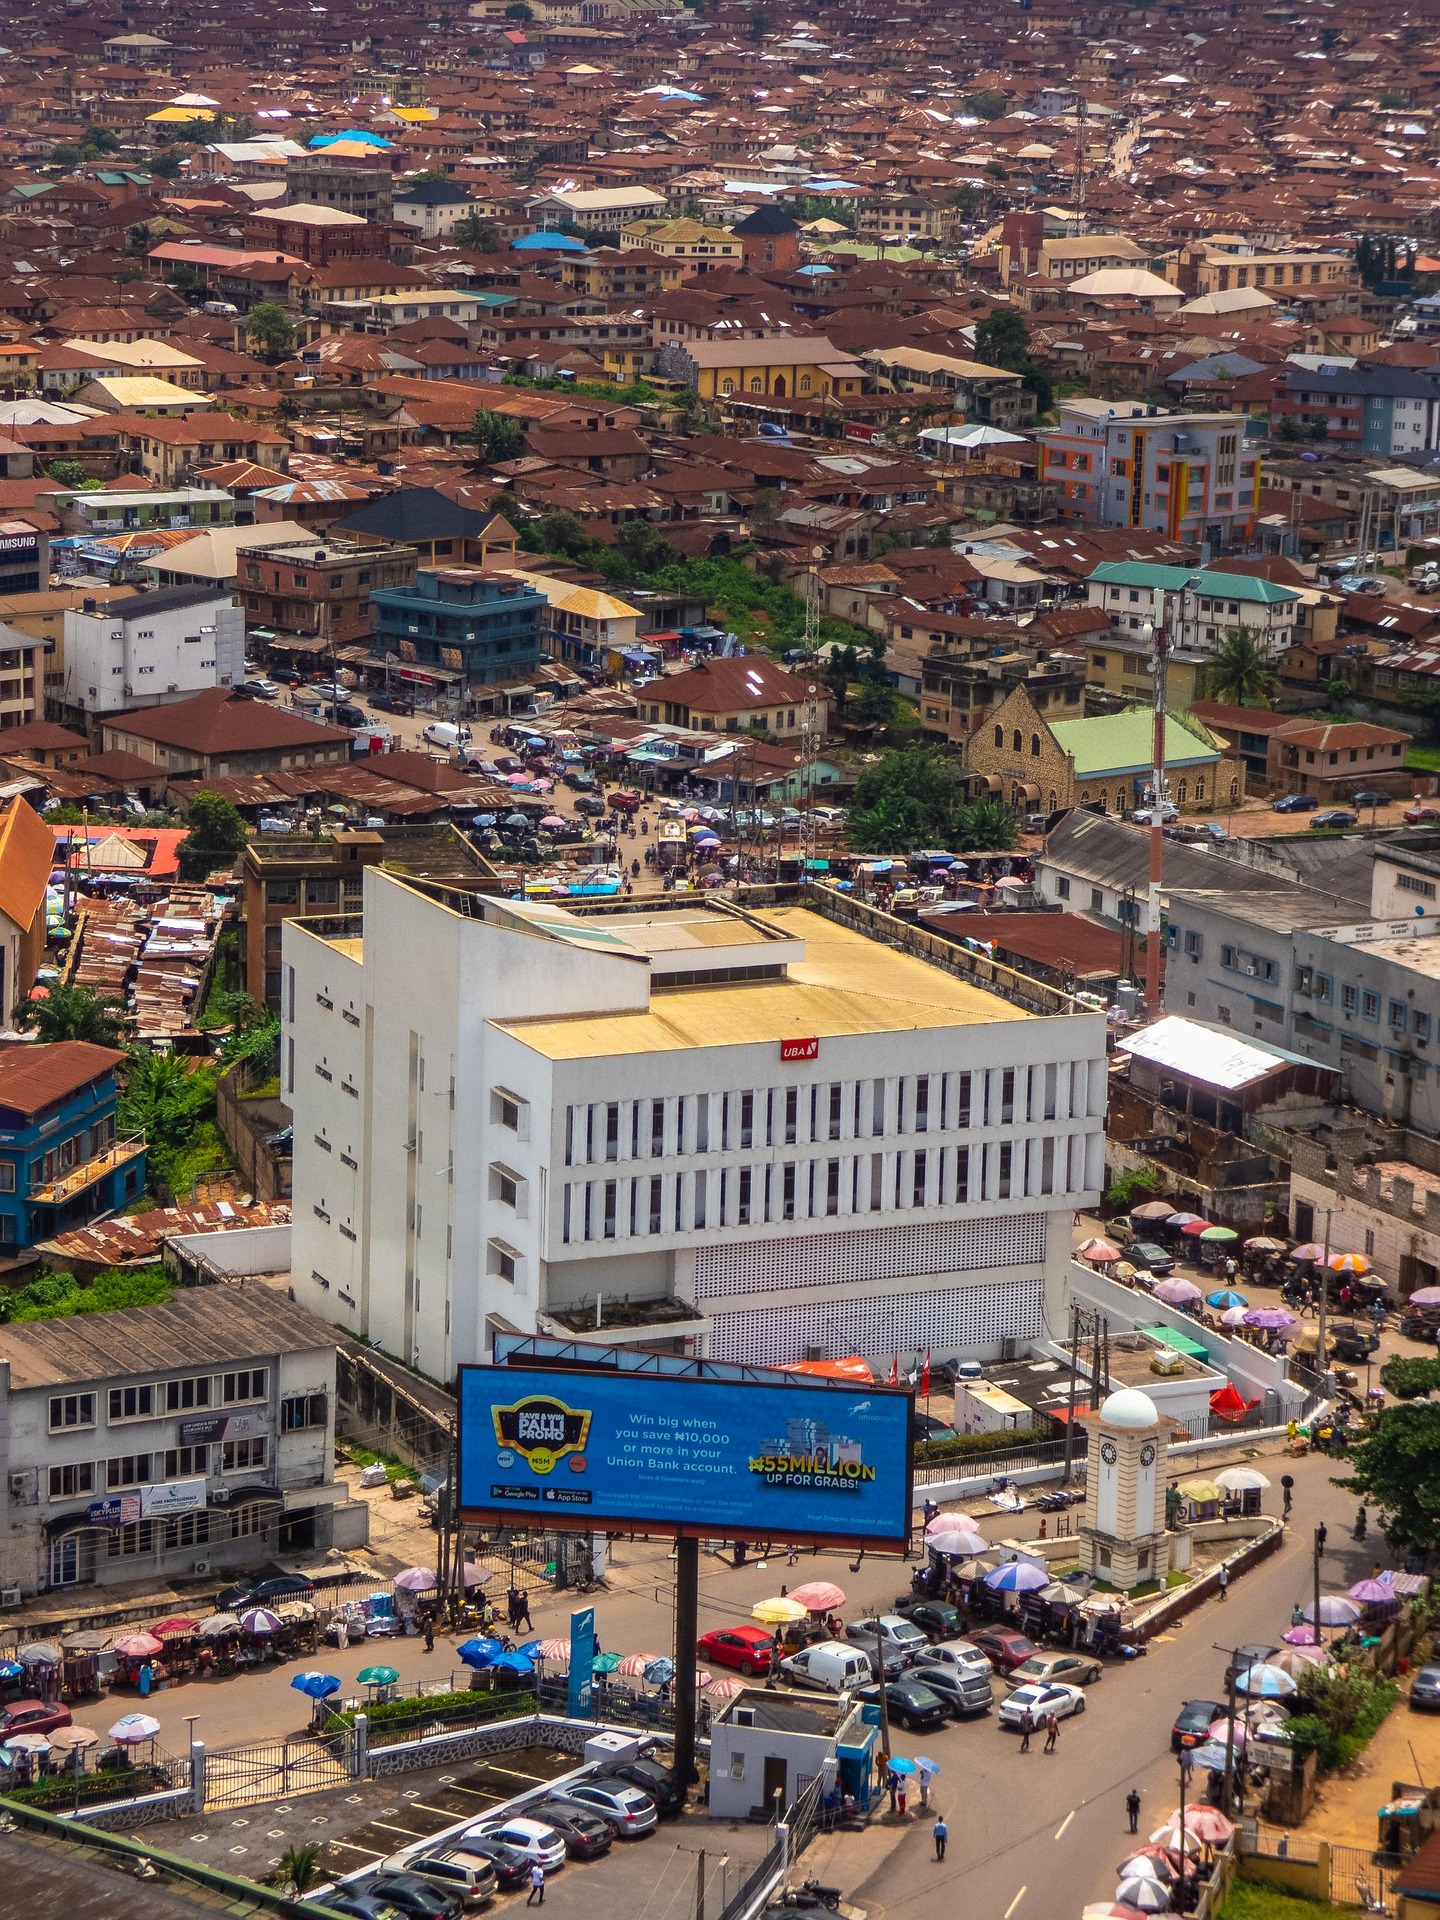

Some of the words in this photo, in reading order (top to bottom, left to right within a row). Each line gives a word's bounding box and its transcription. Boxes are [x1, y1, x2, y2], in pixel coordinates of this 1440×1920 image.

[784, 1046, 805, 1056] UBA
[519, 1412, 540, 1420] SAVE
[519, 1419, 564, 1432] PALLI
[630, 1414, 654, 1425] Win
[658, 1416, 678, 1428] big
[683, 1418, 716, 1429] when
[519, 1430, 564, 1440] PROMO
[616, 1430, 638, 1439] you
[642, 1431, 670, 1440] save
[624, 1444, 636, 1452] or
[641, 1446, 673, 1455] more
[678, 1446, 688, 1456] in
[693, 1449, 722, 1459] your
[607, 1456, 644, 1468] Union
[648, 1458, 680, 1470] Bank
[684, 1462, 737, 1474] account.
[766, 1474, 782, 1484] UP
[786, 1475, 810, 1486] FOR
[814, 1476, 858, 1489] GRABS!
[504, 1490, 524, 1498] Google
[558, 1494, 571, 1502] App
[598, 1491, 629, 1499] Download
[850, 1517, 876, 1525] Smarter
